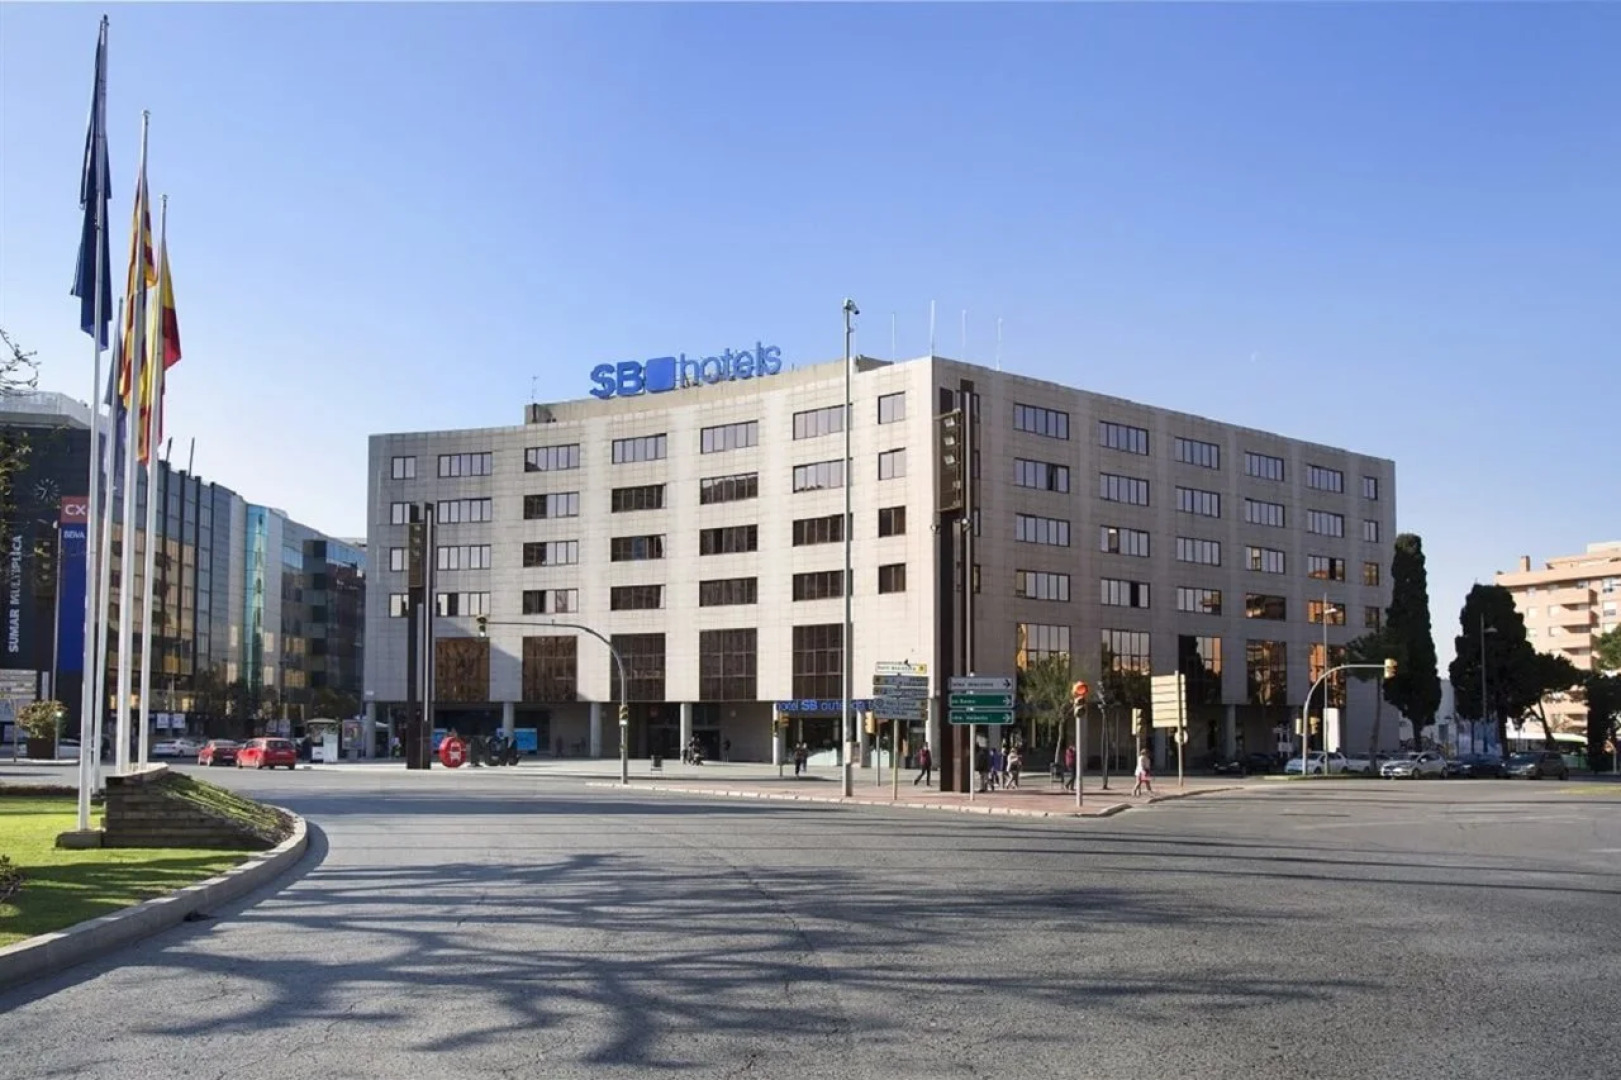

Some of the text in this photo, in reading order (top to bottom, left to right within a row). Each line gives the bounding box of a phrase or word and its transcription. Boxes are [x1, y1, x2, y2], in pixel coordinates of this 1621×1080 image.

[589, 341, 782, 399] SB hotels
[65, 504, 86, 516] CX
[64, 530, 85, 539] BBVA
[8, 609, 20, 653] SUMAR
[801, 699, 818, 711] SB
